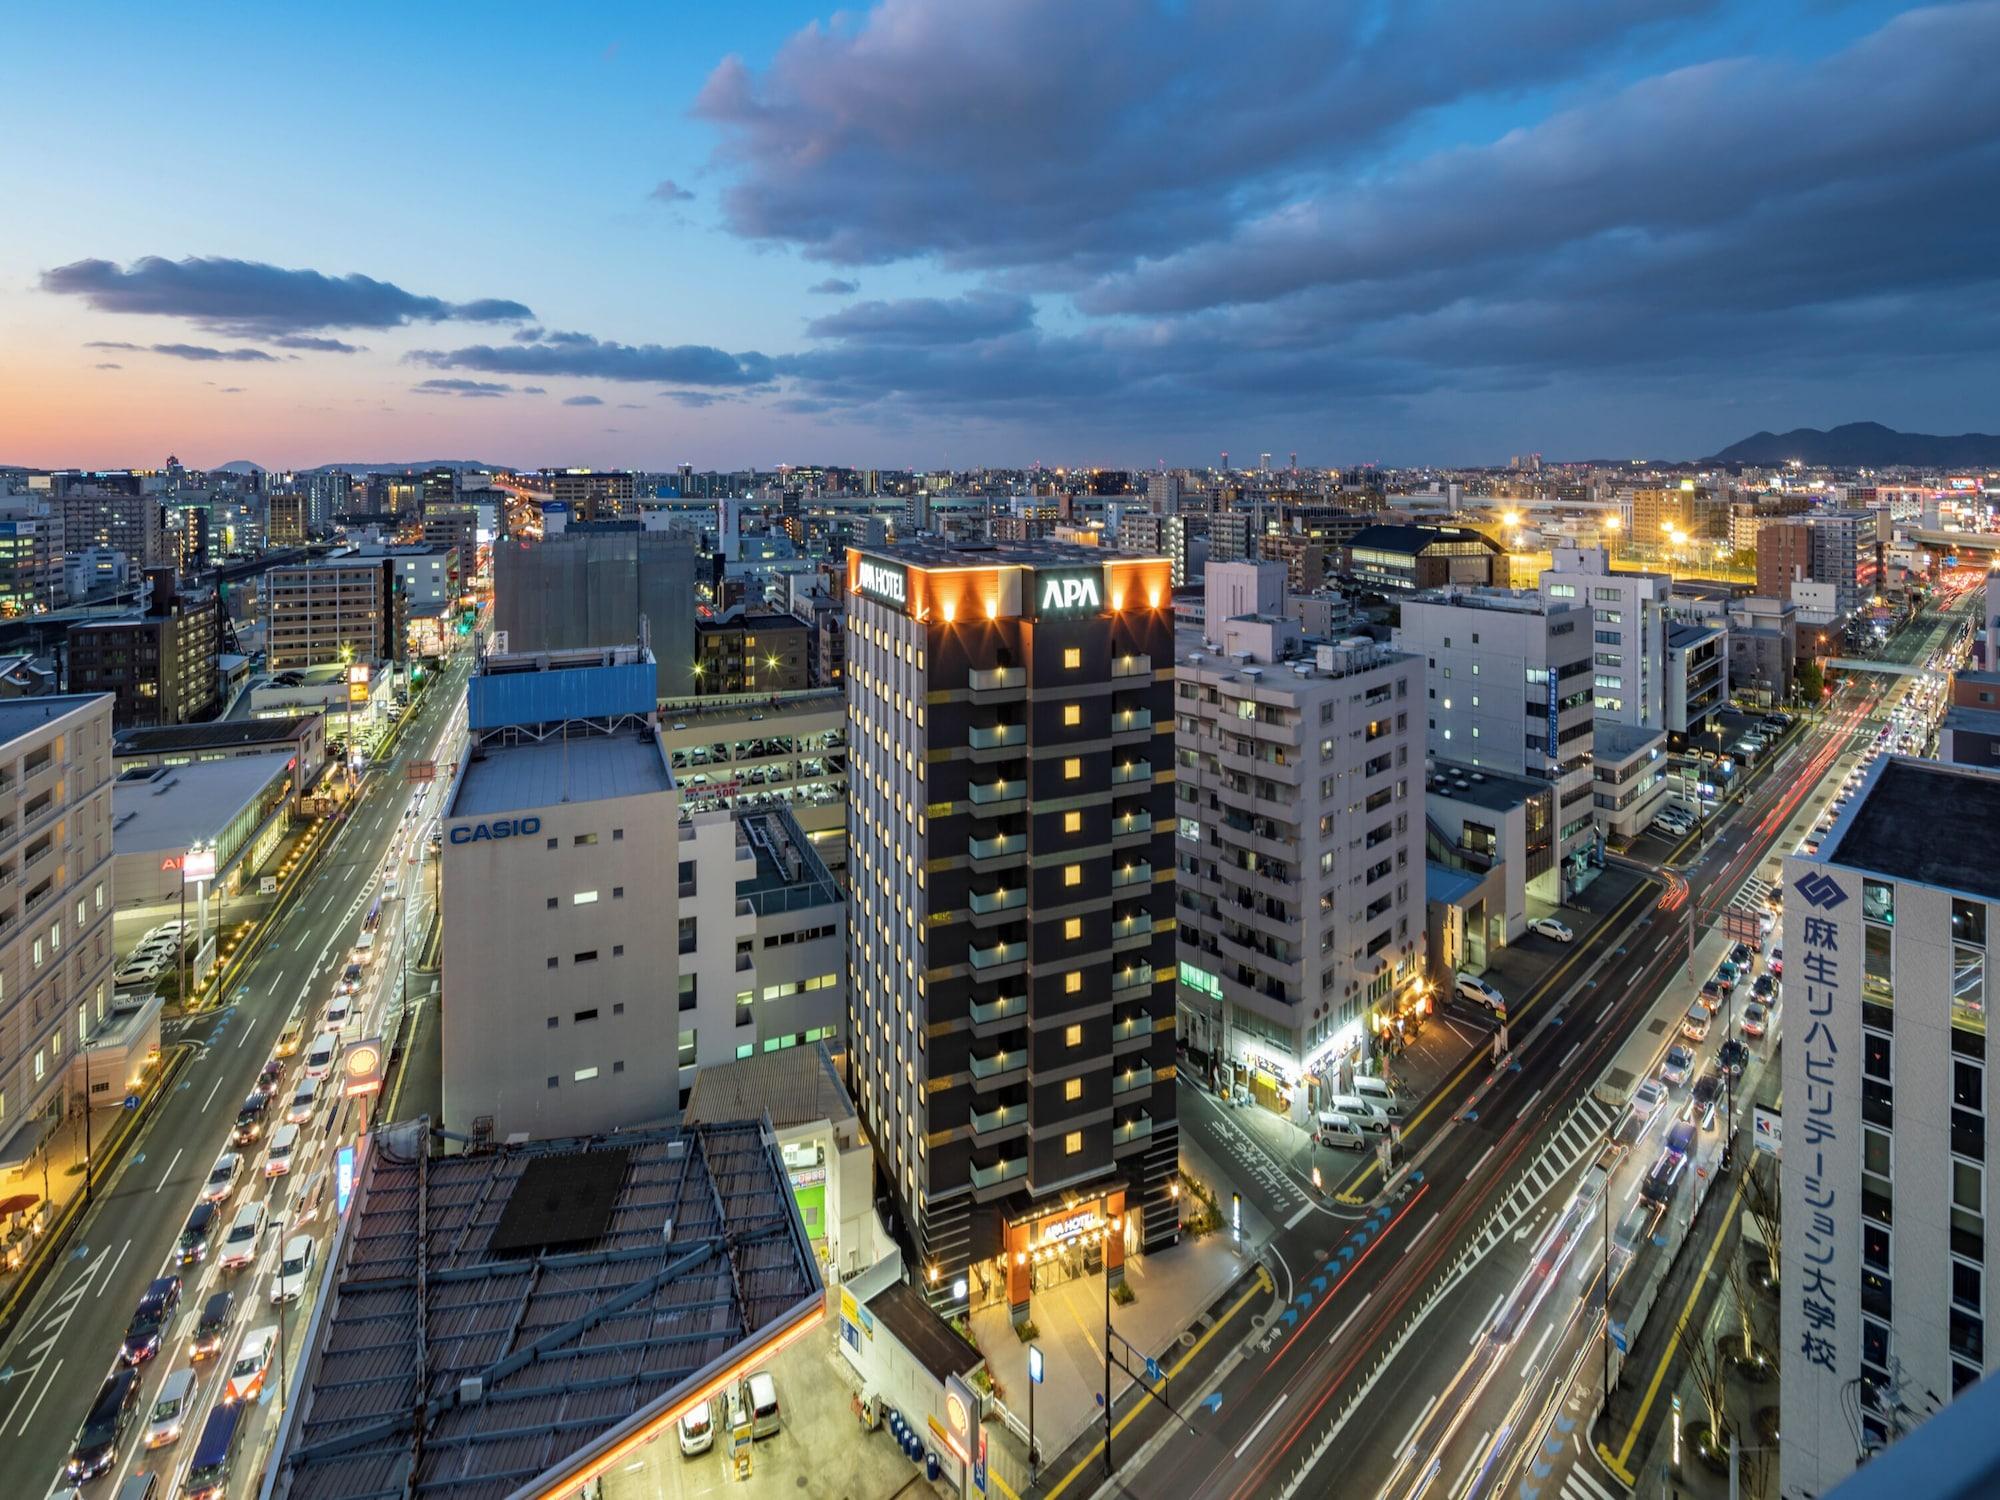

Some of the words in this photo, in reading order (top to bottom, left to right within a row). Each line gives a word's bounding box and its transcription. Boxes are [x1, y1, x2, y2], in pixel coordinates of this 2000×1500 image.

[875, 567, 905, 602] HOTEL
[1042, 578, 1100, 609] APA
[450, 817, 541, 845] CASIO
[1802, 917, 1839, 1373] 麻生リハビリテーション大学校
